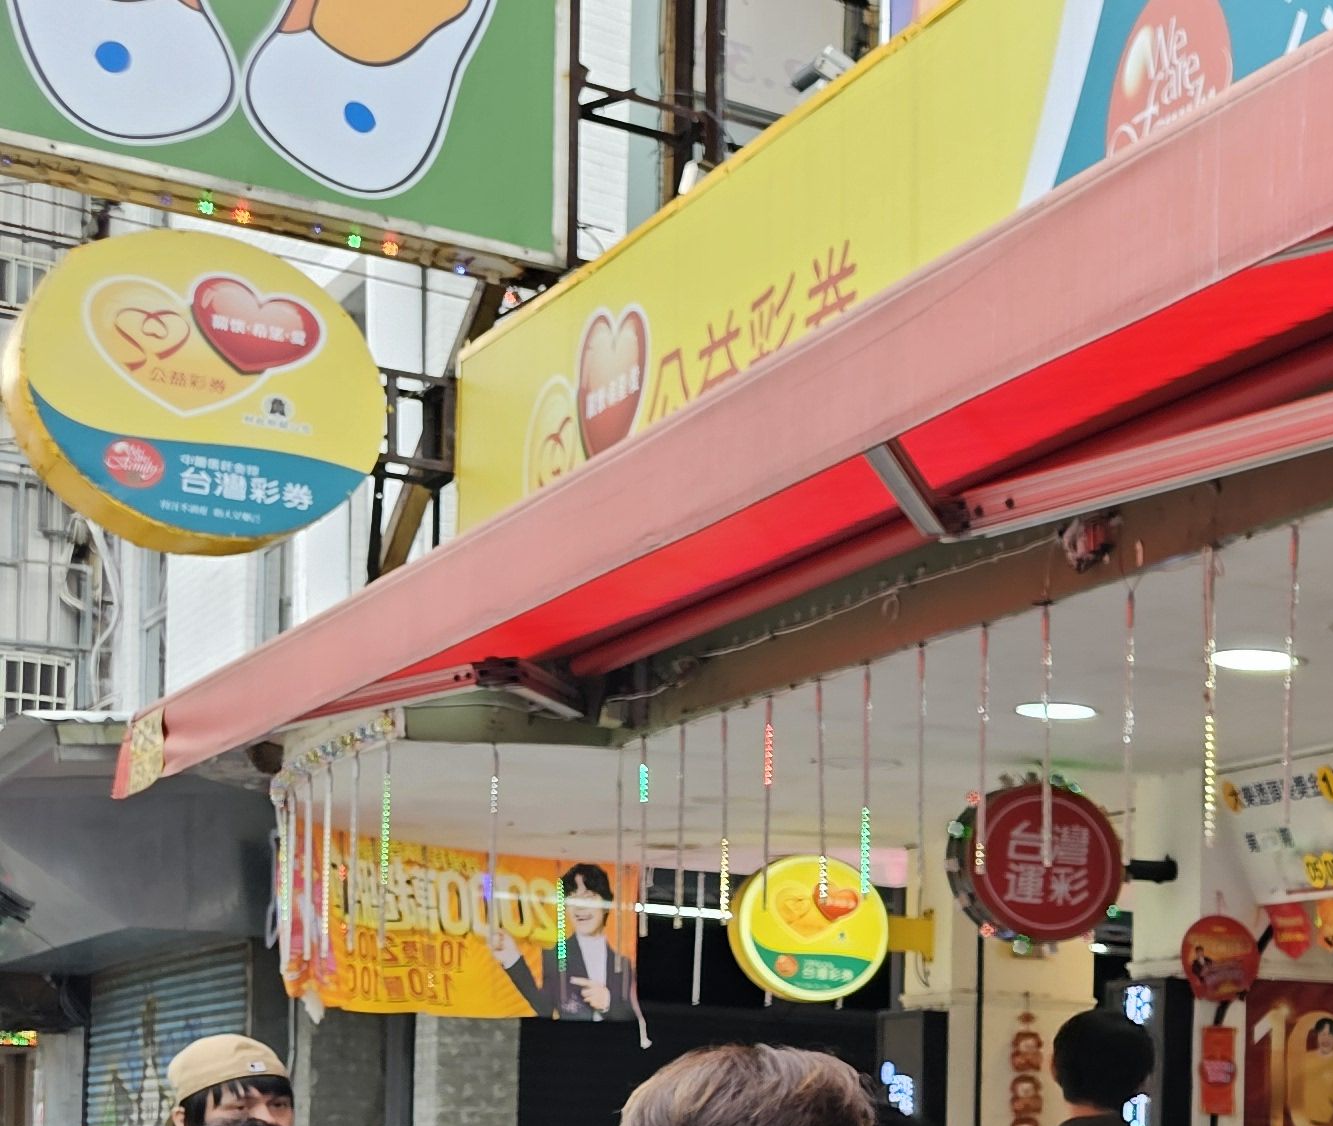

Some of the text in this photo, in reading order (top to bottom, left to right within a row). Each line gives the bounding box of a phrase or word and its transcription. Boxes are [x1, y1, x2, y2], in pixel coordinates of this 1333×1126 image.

[179, 469, 314, 511] 台灣彩券
[1004, 863, 1089, 906] 運彩
